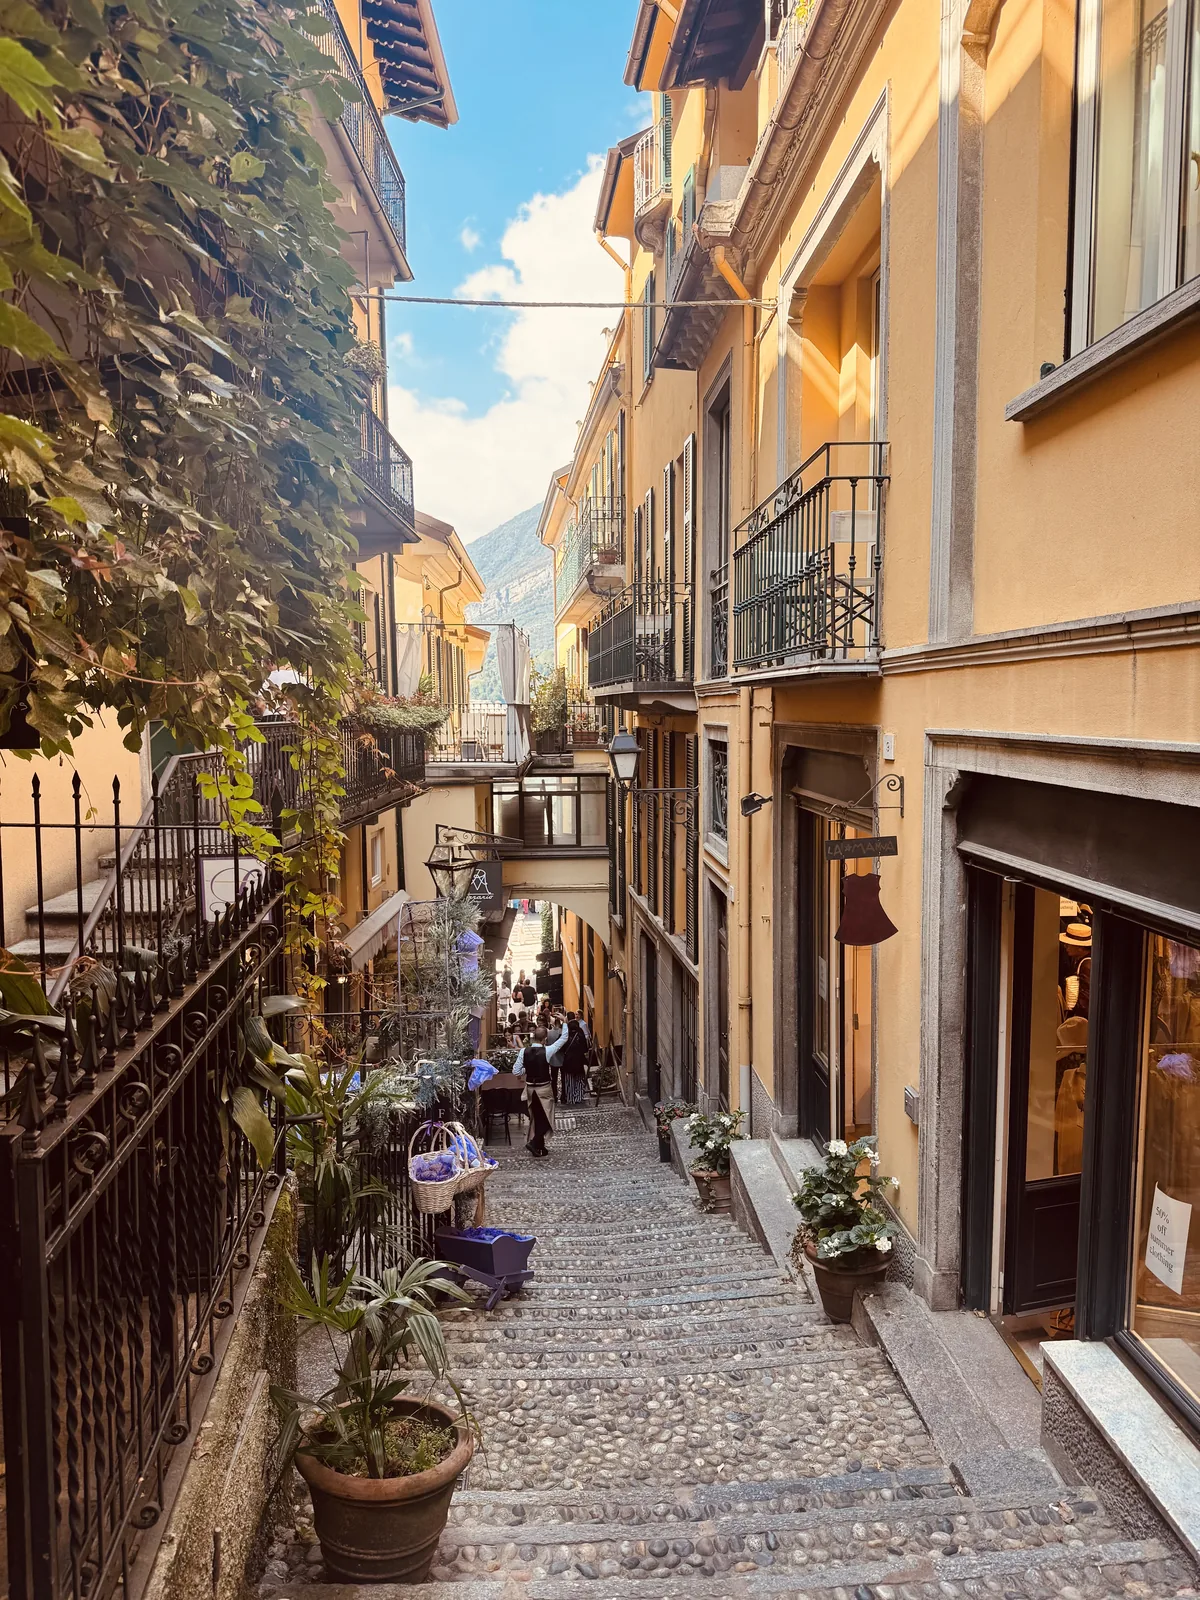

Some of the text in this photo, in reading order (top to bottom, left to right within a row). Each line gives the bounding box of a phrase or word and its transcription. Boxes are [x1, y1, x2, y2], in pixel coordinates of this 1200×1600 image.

[1155, 1206, 1170, 1224] 50%
[1157, 1224, 1168, 1236] off
[1150, 1232, 1175, 1256] summer
[1149, 1245, 1174, 1273] clothing
